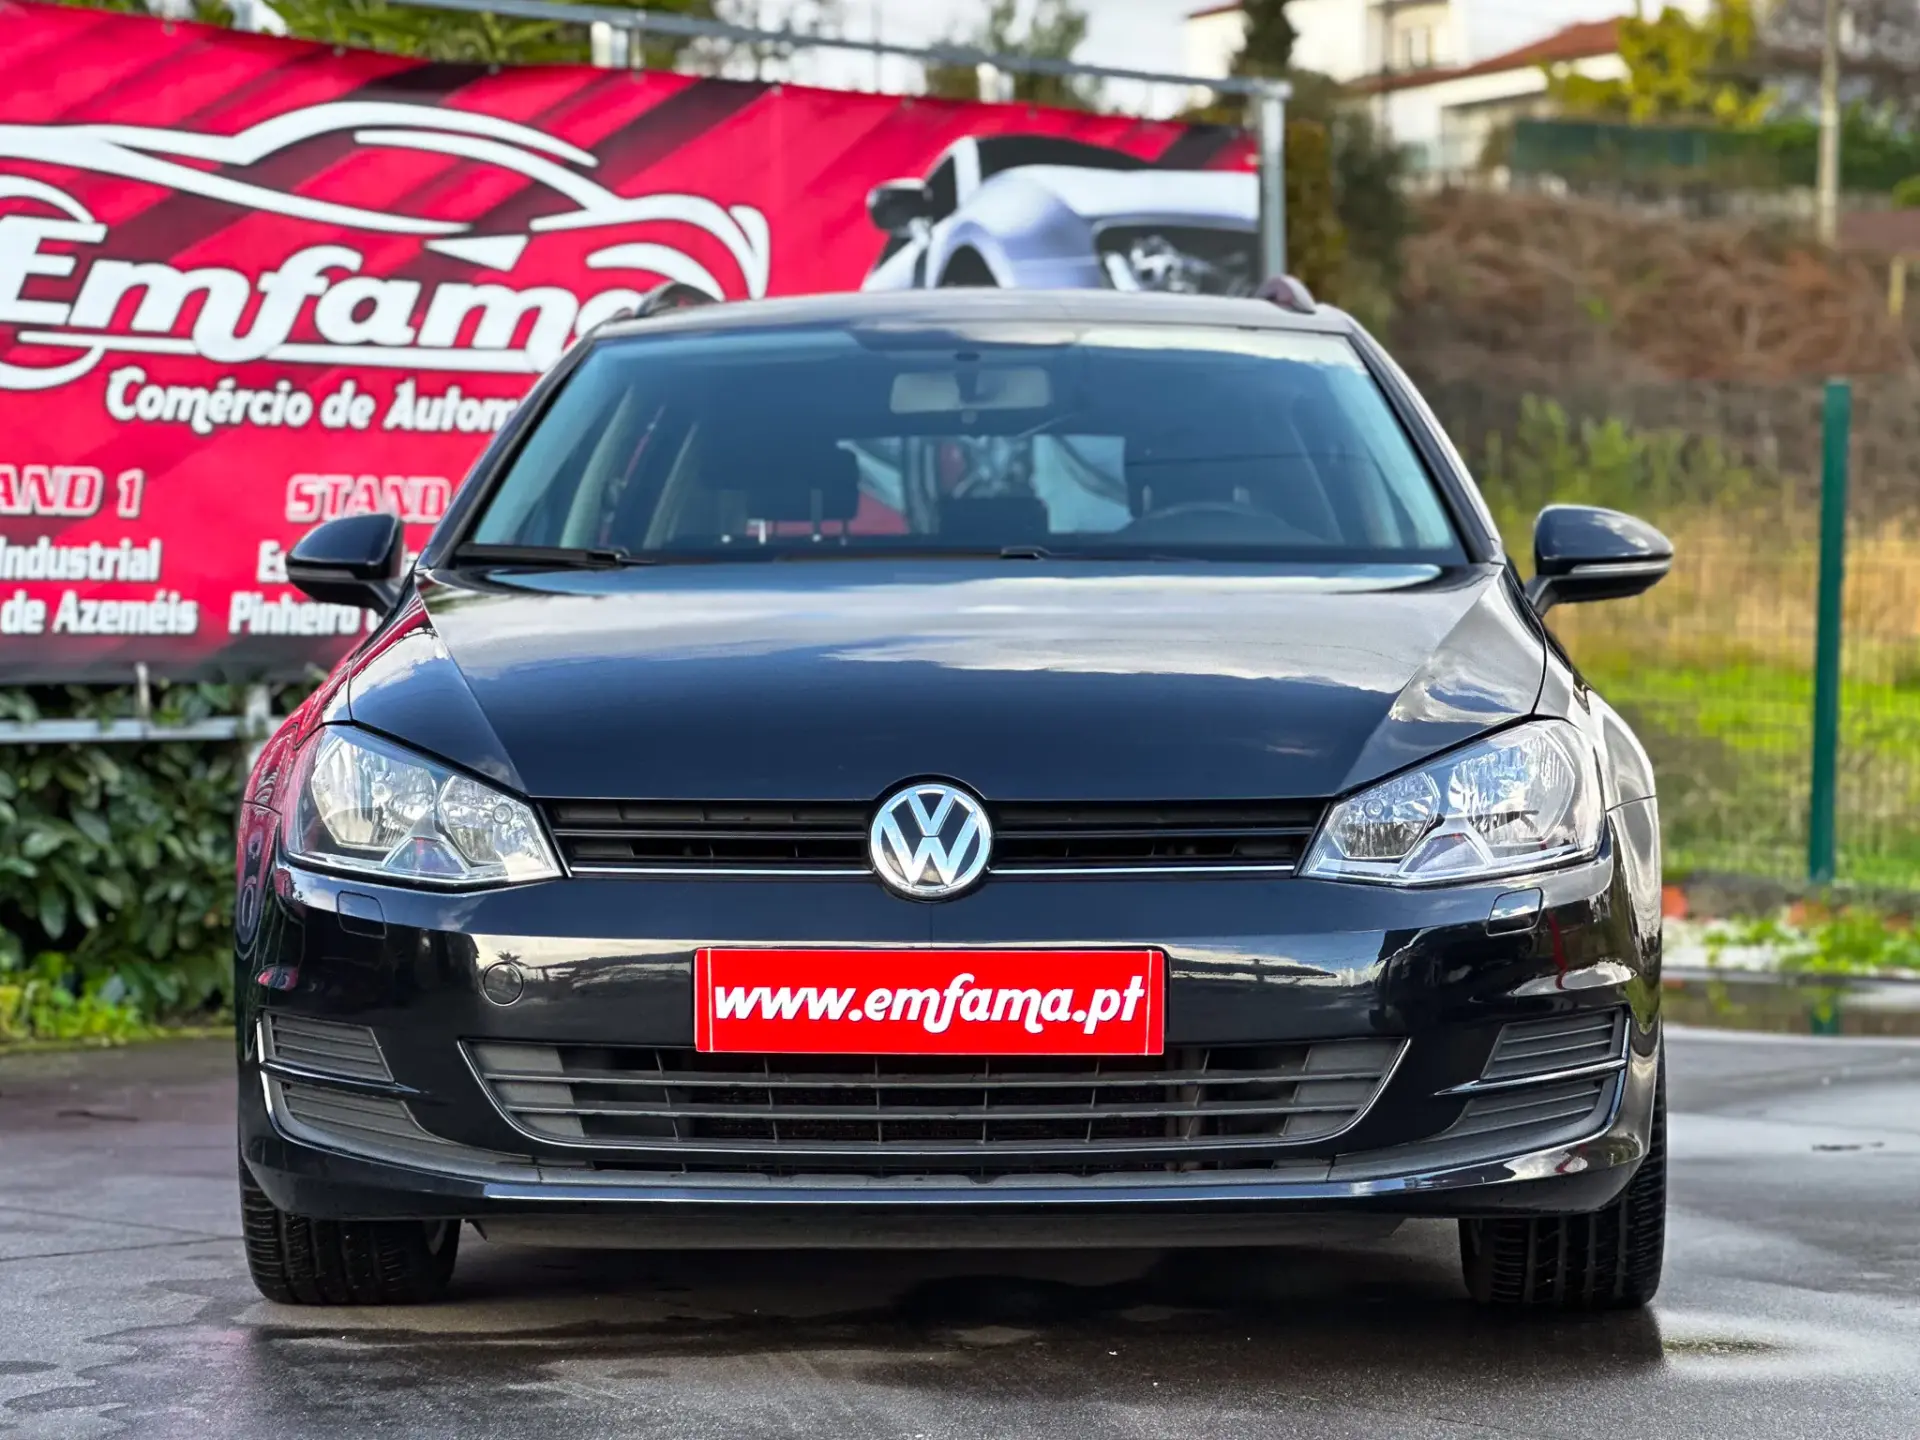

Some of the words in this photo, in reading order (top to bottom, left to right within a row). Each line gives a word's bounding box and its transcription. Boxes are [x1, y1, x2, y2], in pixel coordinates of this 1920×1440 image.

[106, 366, 313, 434] Comércio
[320, 380, 376, 430] de
[117, 468, 144, 518] 1
[286, 474, 452, 524] STAND
[1, 590, 46, 633] de
[52, 590, 198, 634] Azeméis
[228, 592, 361, 634] Pinheiro
[714, 973, 1145, 1035] www.emfama.pt
